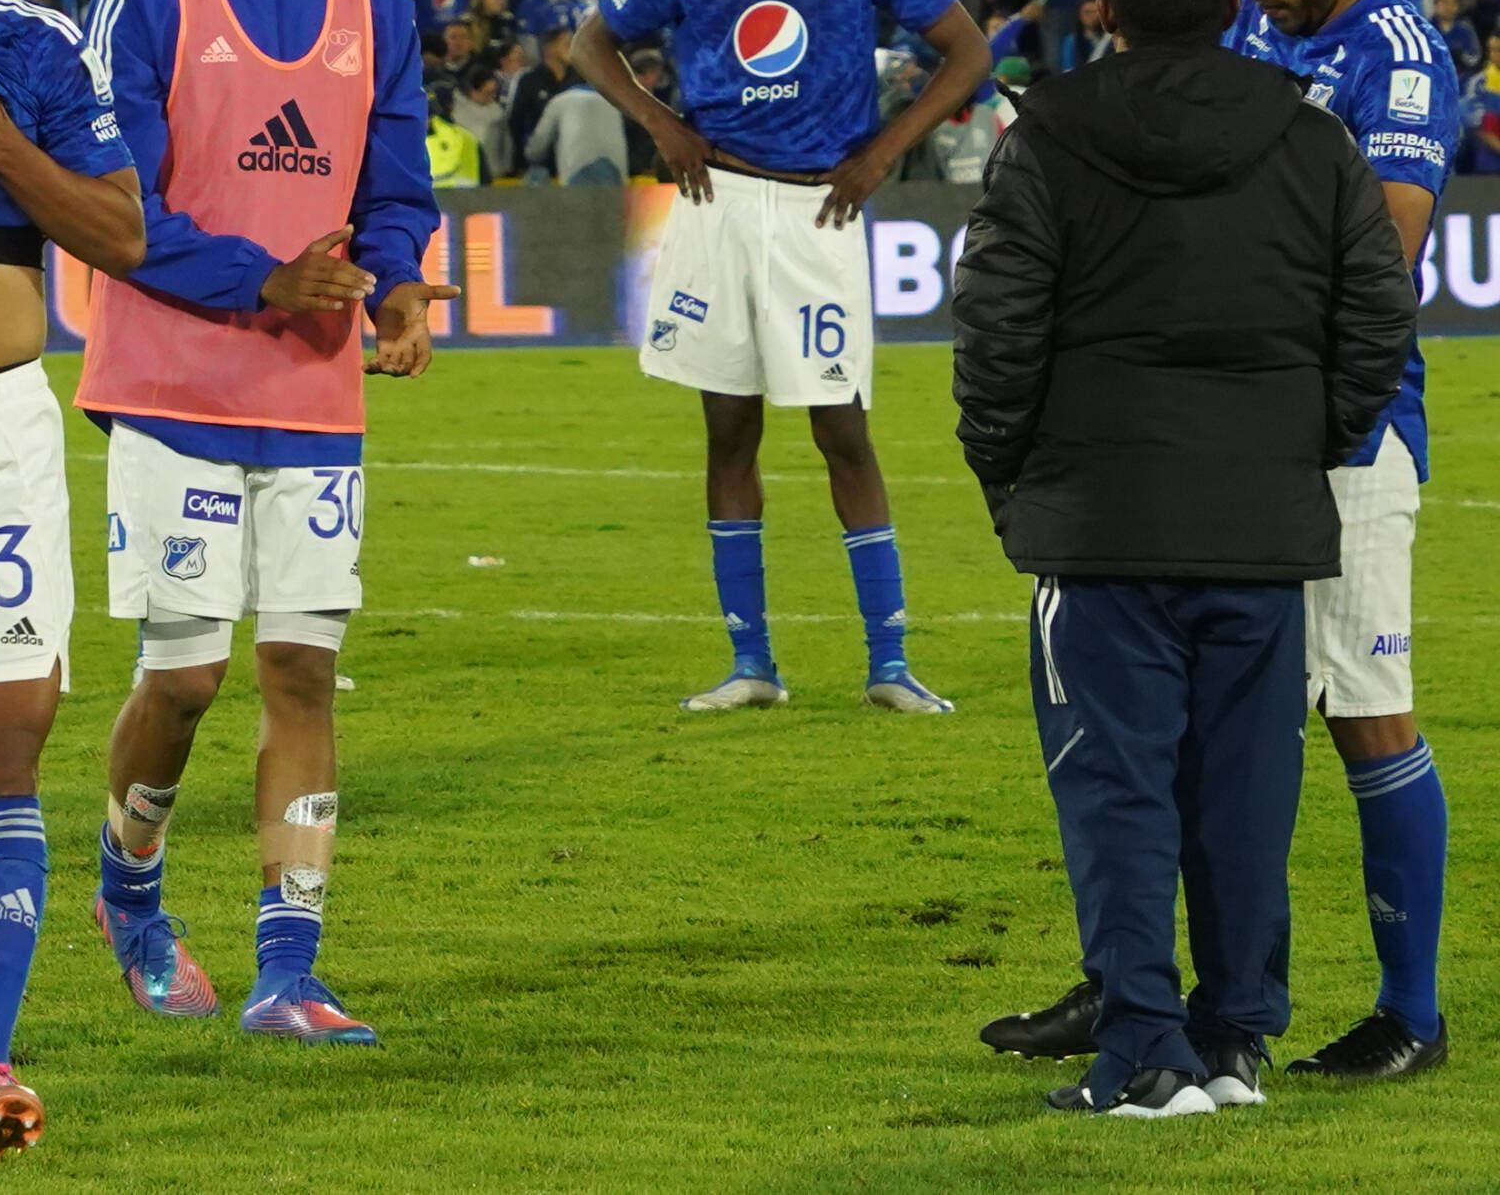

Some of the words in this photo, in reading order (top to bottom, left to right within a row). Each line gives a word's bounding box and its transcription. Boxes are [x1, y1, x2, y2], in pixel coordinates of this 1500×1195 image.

[741, 81, 800, 105] pepsi
[237, 145, 332, 177] adidas
[798, 302, 846, 359] 16
[307, 468, 362, 540] 30
[0, 634, 45, 647] adidas
